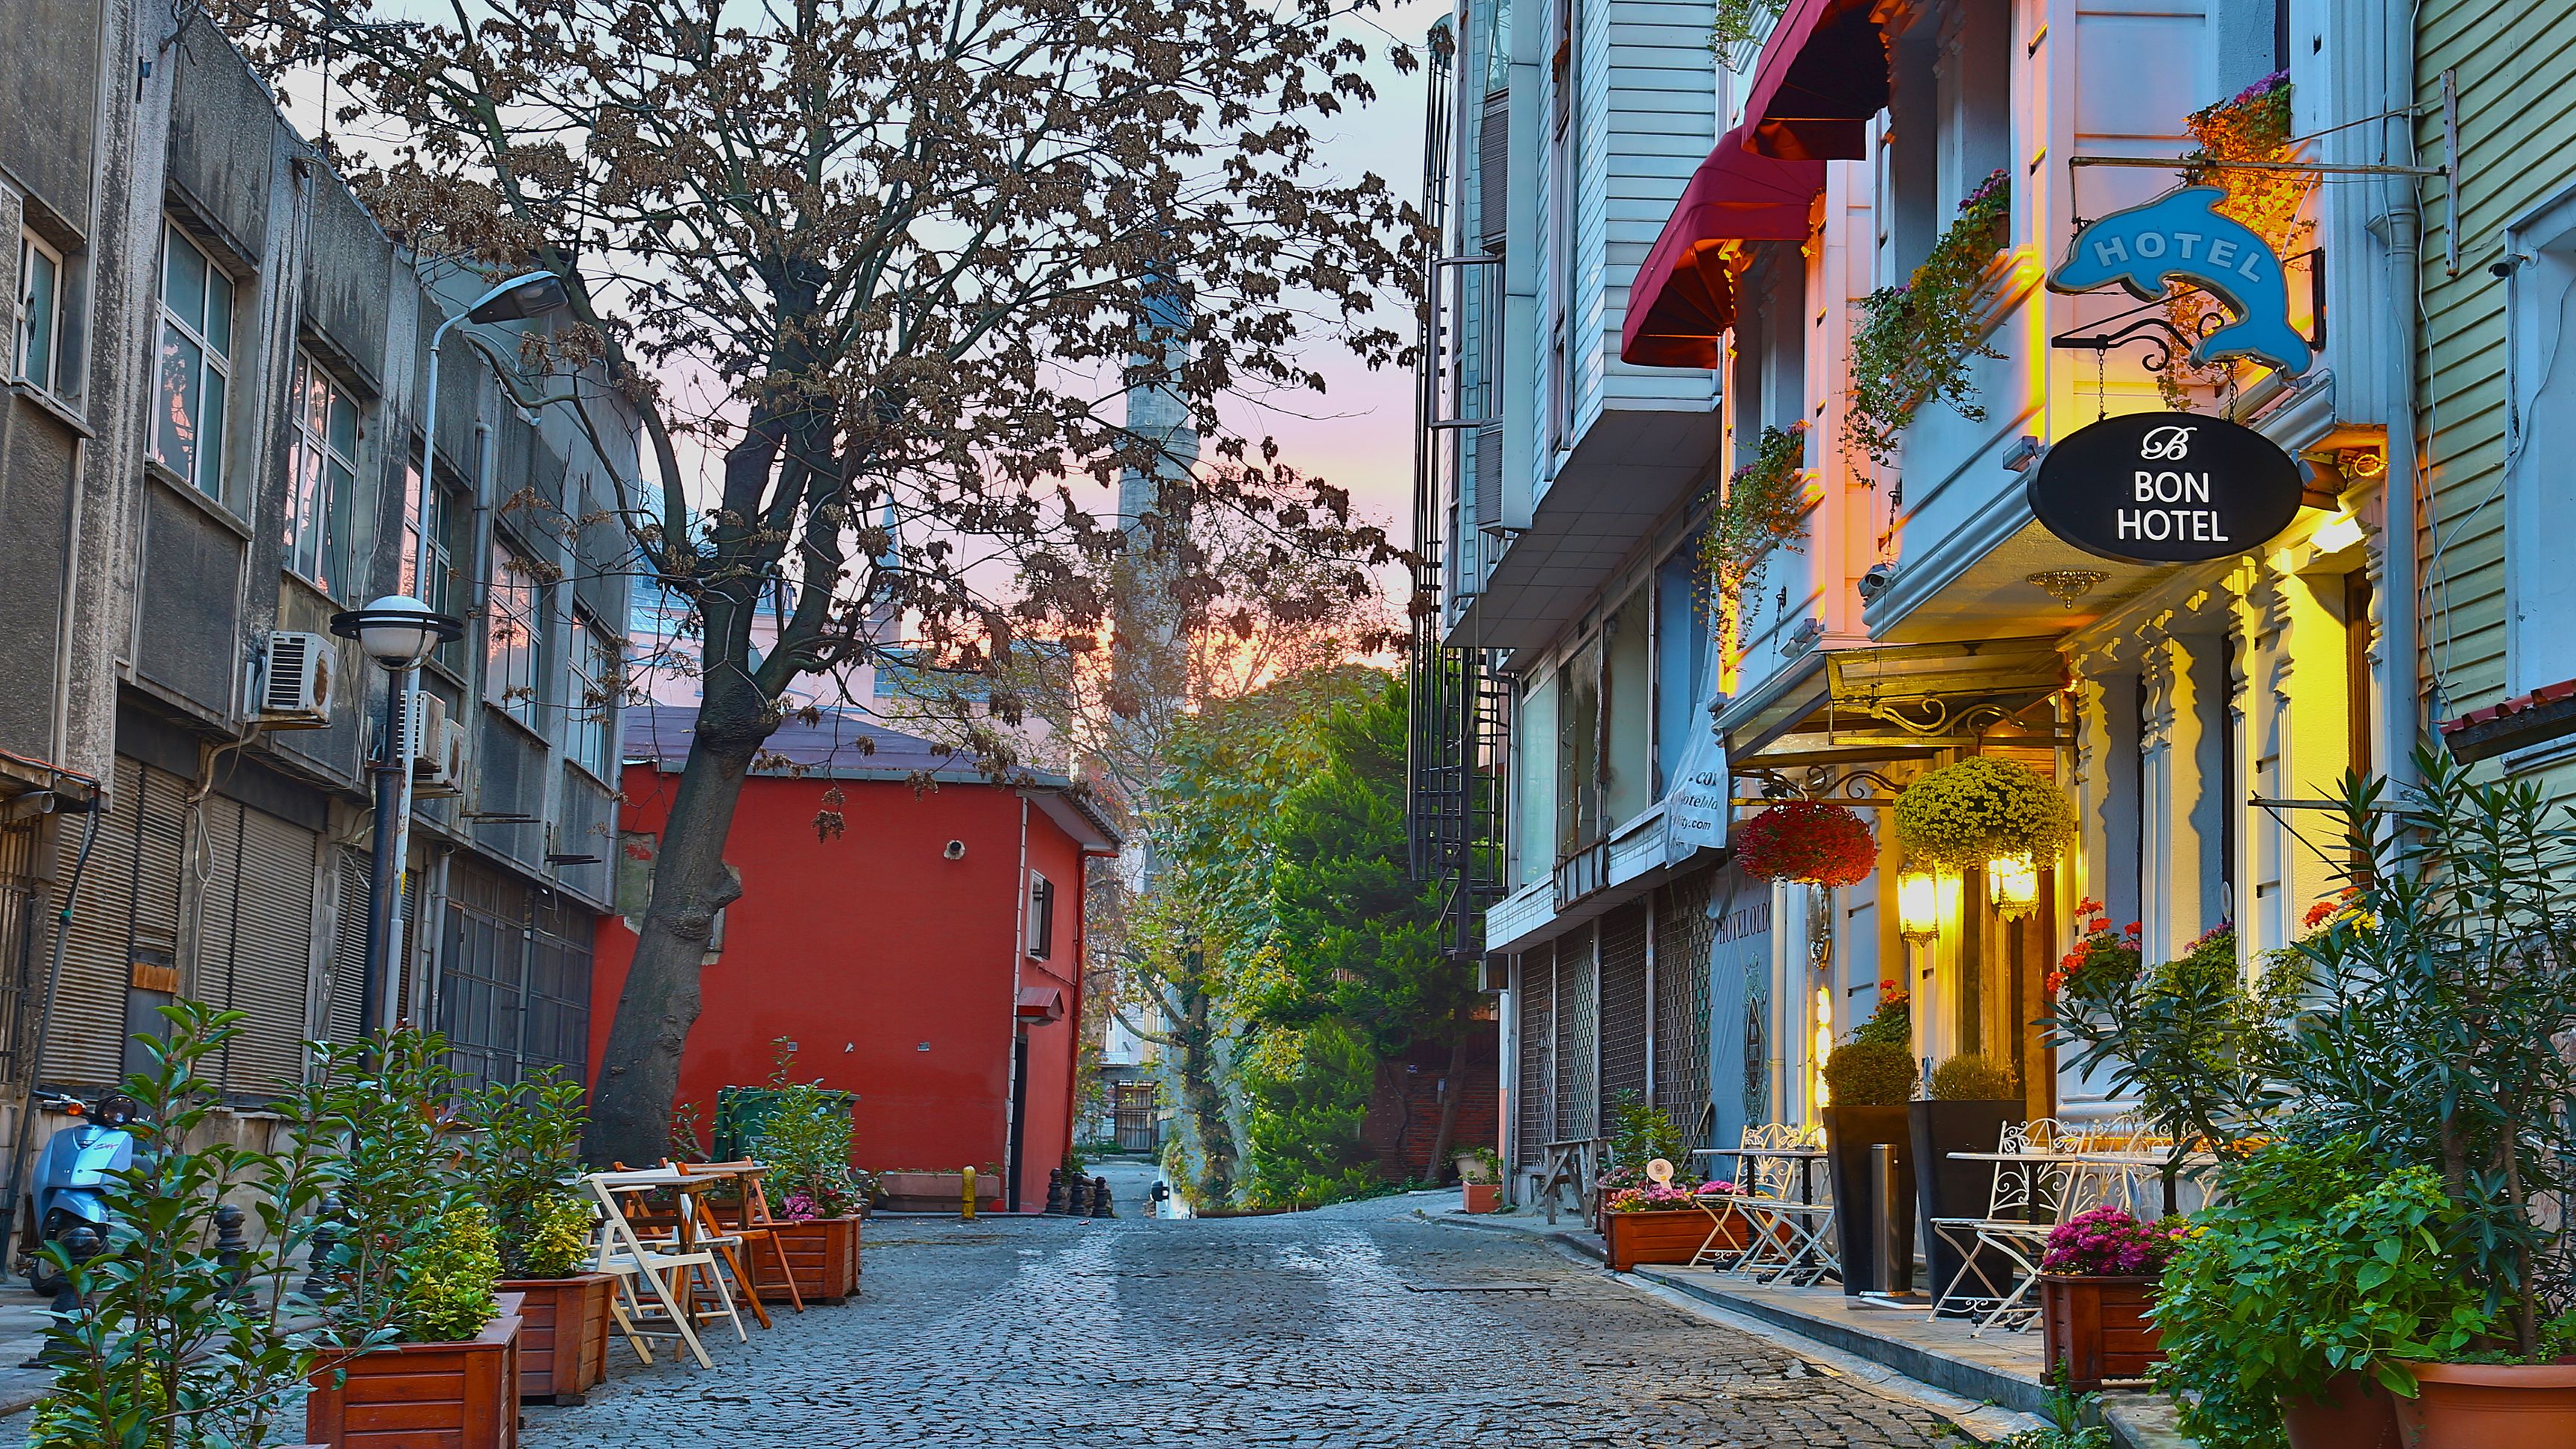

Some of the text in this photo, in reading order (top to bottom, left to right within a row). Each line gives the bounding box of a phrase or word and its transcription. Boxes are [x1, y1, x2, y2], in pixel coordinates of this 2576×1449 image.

[2094, 232, 2261, 282] HOTEL
[2140, 426, 2197, 460] B
[2134, 471, 2209, 503] BON
[2118, 509, 2229, 542] HOTEL
[1719, 908, 1749, 944] HOTEL
